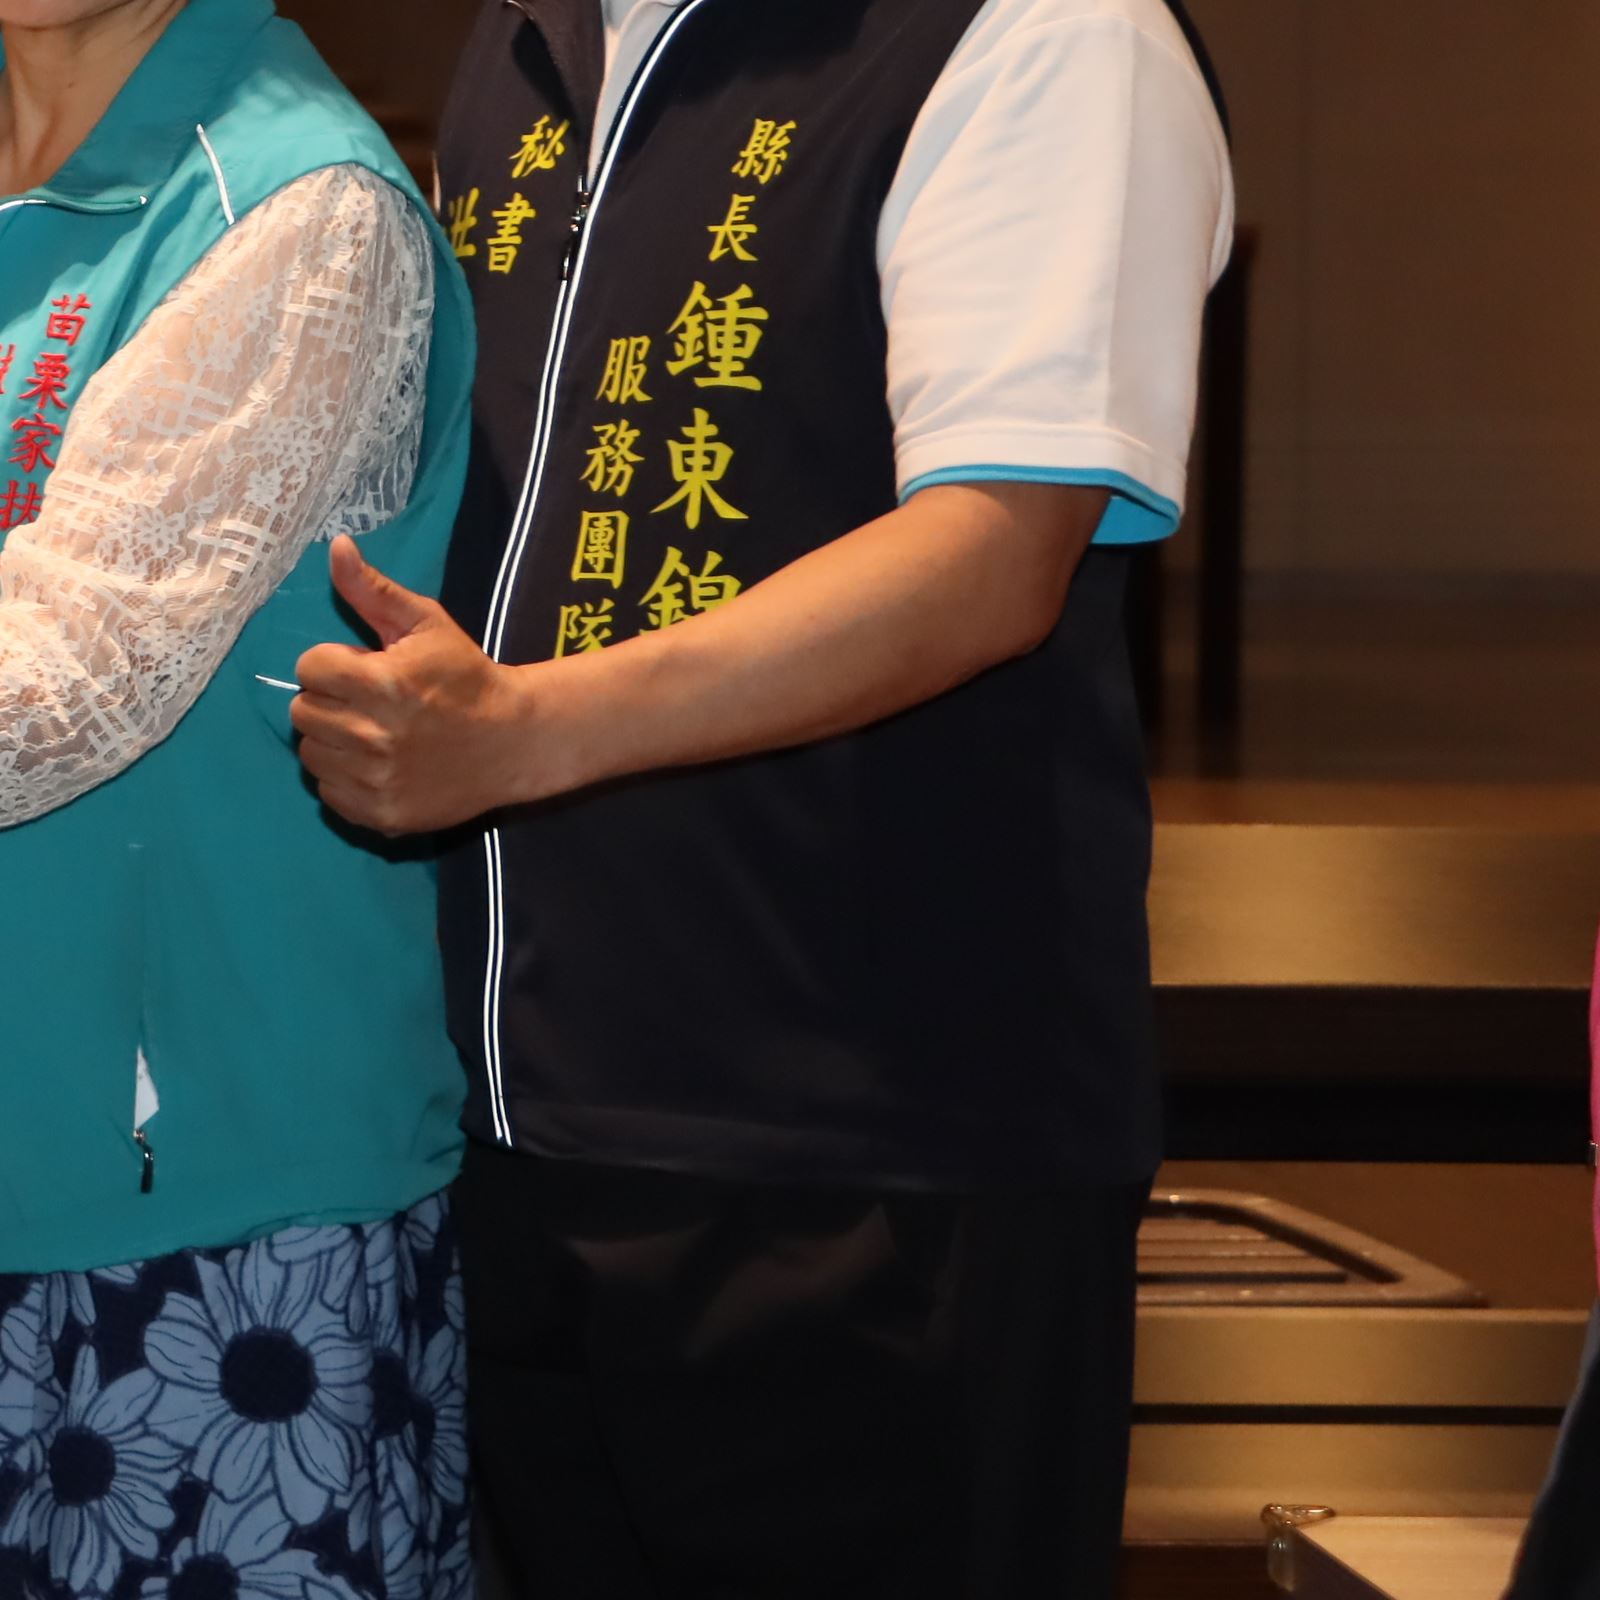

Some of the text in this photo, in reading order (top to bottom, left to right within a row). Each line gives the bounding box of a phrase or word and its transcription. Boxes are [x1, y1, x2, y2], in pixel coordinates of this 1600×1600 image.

[485, 112, 571, 276] 秘書
[553, 334, 654, 660] 服務團隊
